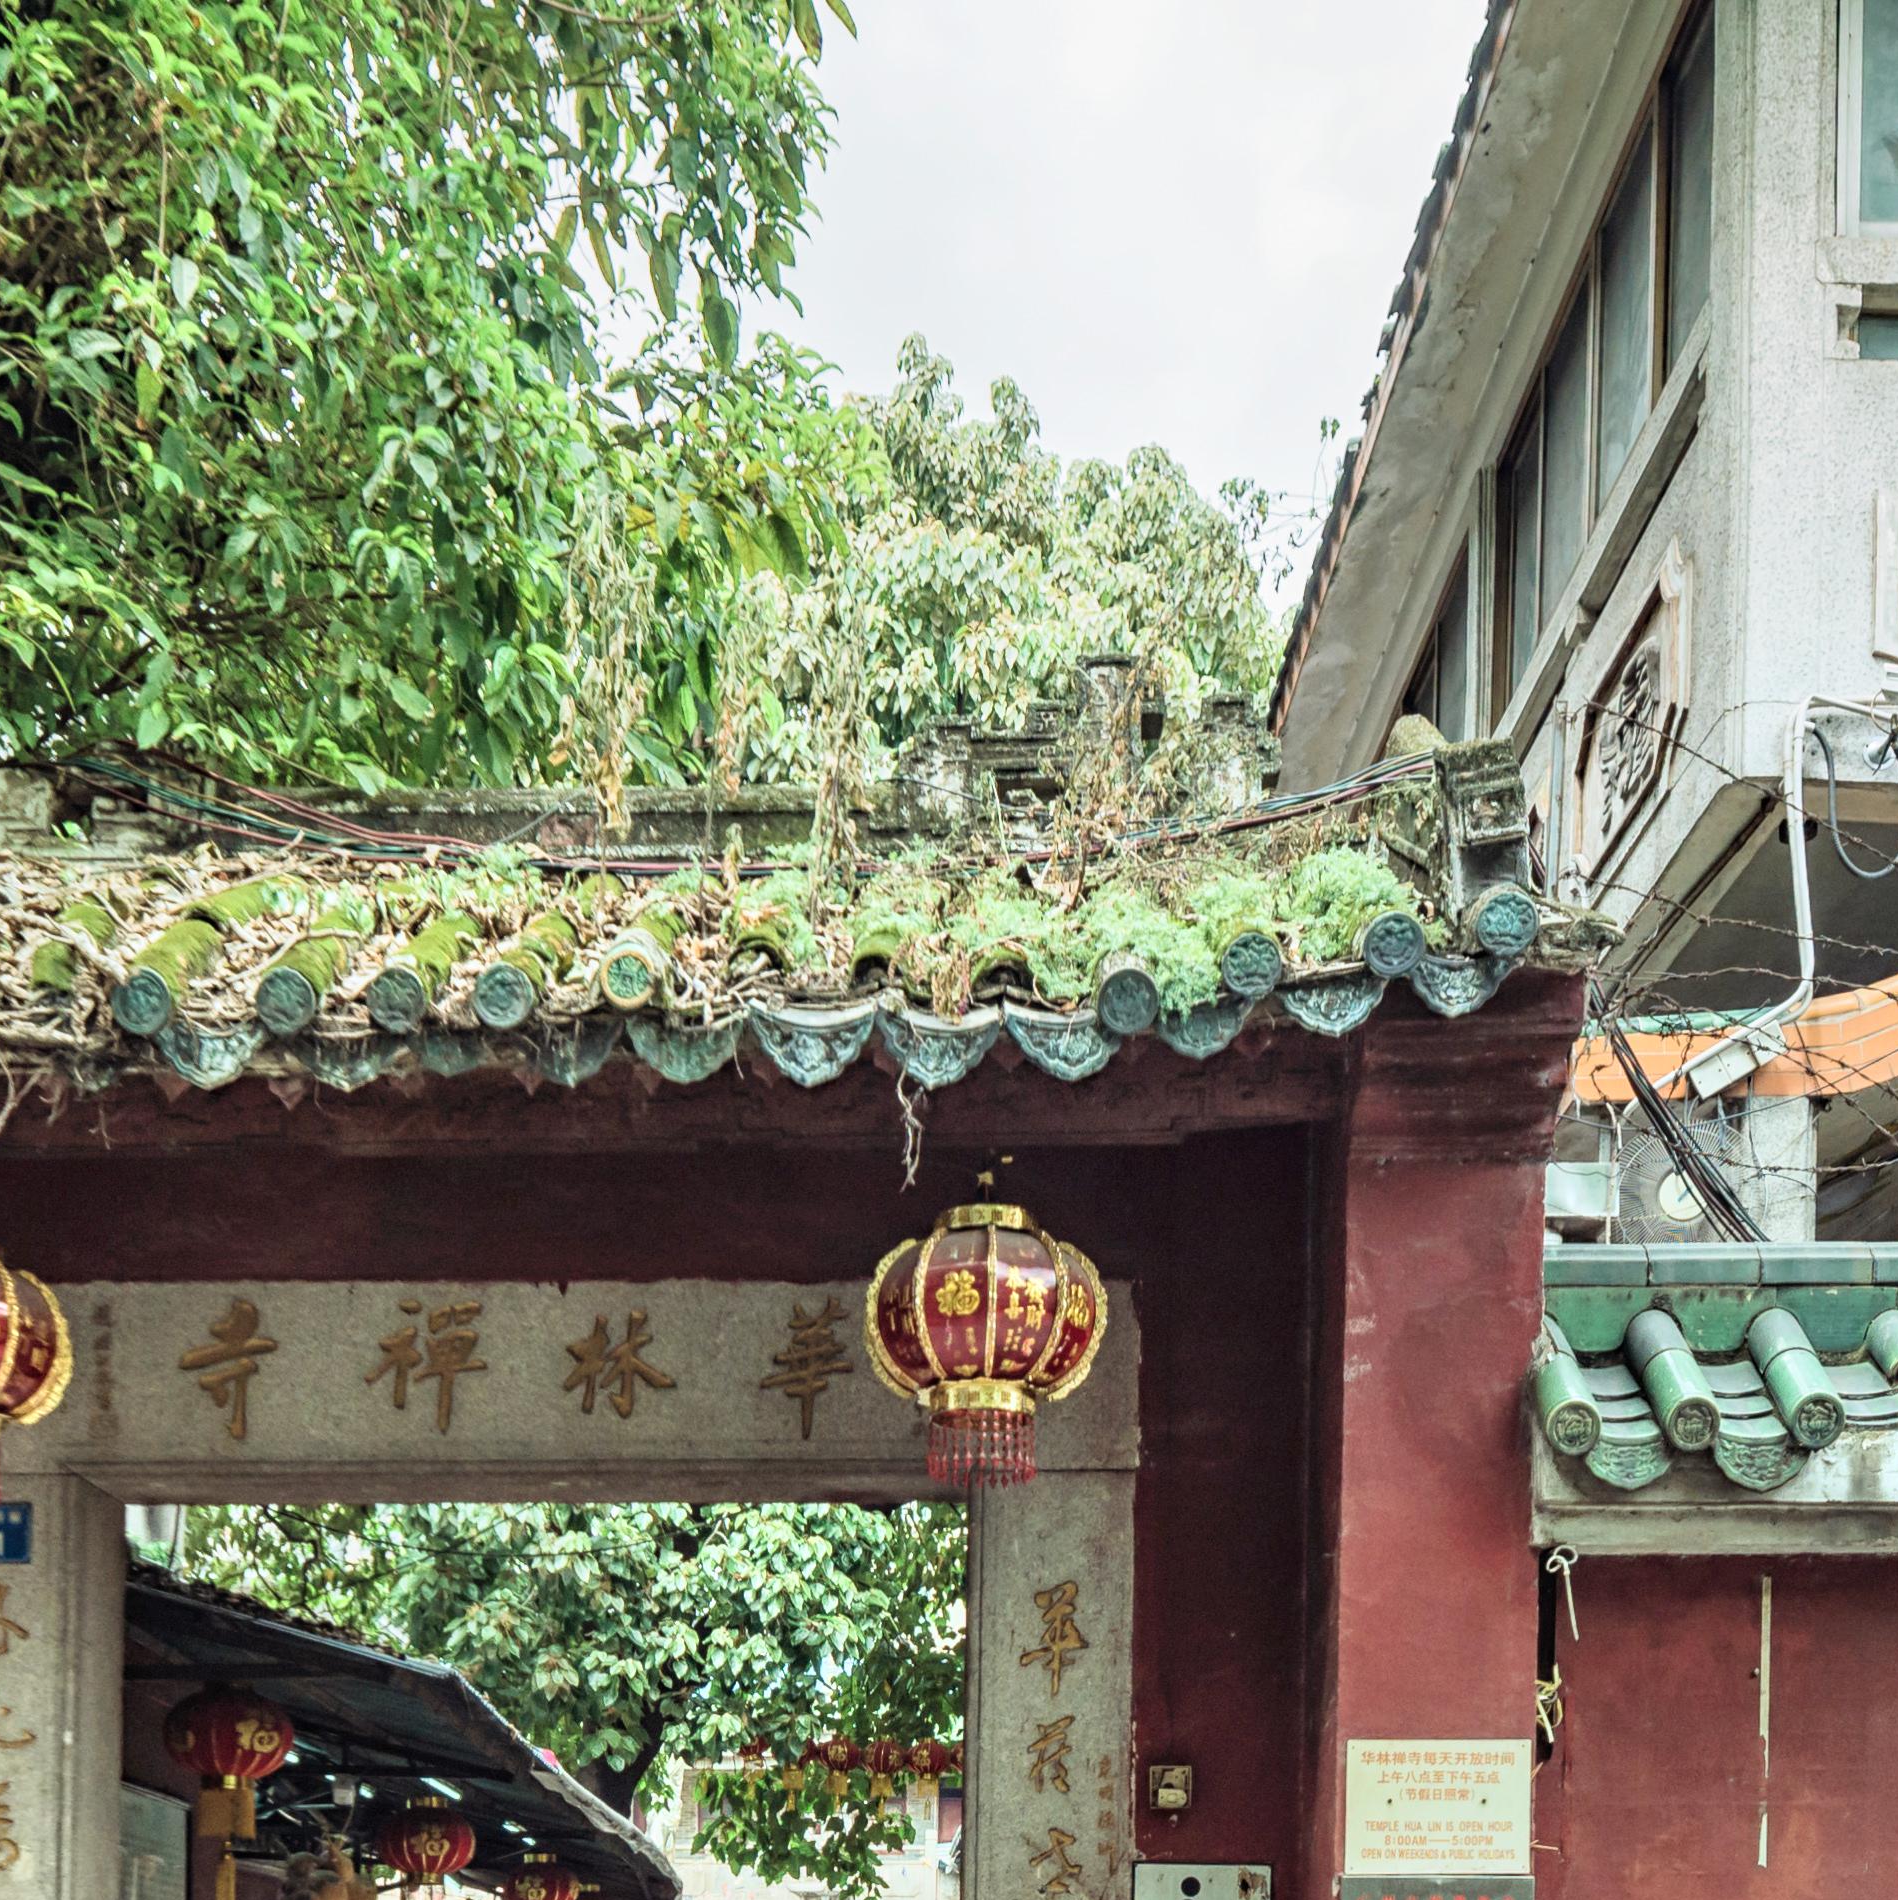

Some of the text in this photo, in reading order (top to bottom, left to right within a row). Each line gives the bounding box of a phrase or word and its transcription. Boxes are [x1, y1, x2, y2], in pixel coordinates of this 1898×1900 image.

[935, 1269, 980, 1316] 福
[1361, 1751, 1516, 1766] 华林禅寺每天开放时间
[1377, 1770, 1501, 1785] 上午八点至下午五点
[1365, 1820, 1513, 1832] TEMPLE HUA LIN IS OPEN HOUR
[1361, 1848, 1383, 1860] OPEN
[1384, 1848, 1397, 1860] ON
[1398, 1848, 1439, 1860] WEEKENDS
[1449, 1848, 1475, 1860] PUBLIC
[1478, 1848, 1516, 1860] HOLIDAYS
